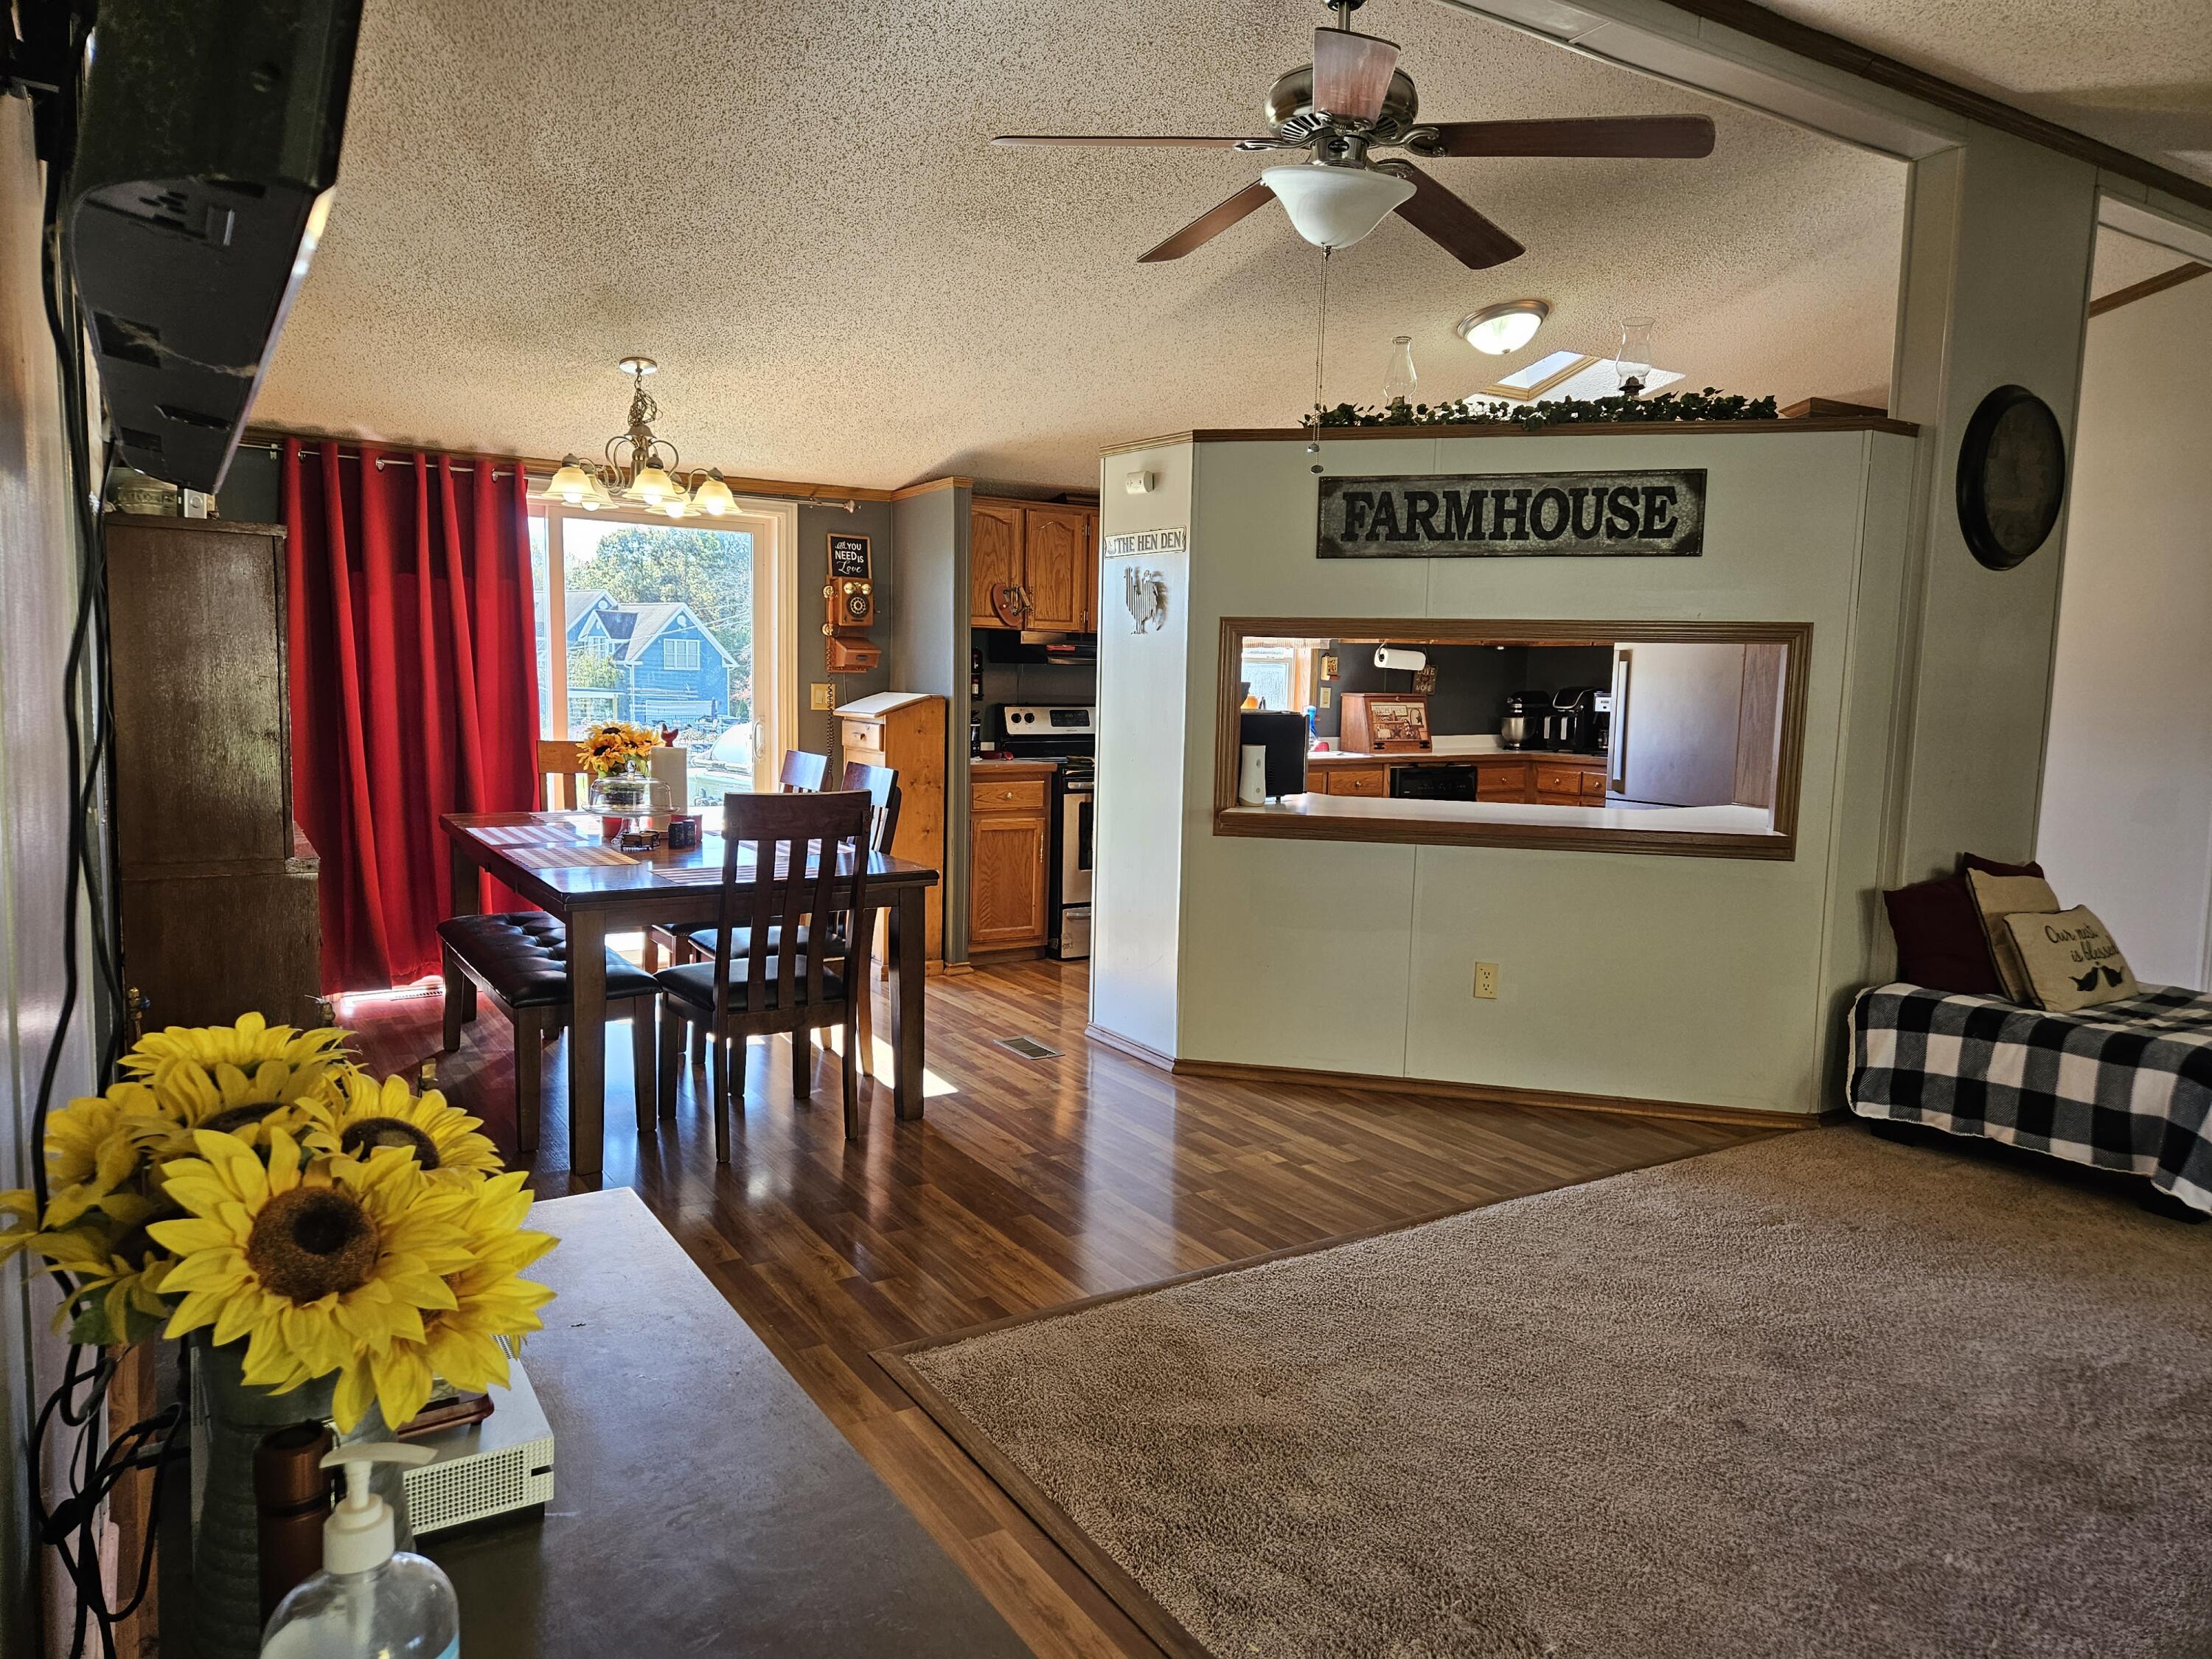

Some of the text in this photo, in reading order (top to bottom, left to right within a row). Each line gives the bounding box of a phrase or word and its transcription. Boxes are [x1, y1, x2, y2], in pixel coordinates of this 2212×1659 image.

[1340, 486, 1678, 542] FARMHOUSE
[846, 543, 862, 551] YOU
[1116, 531, 1181, 554] THE HEN DEN
[835, 550, 864, 563] NEED IS
[836, 560, 863, 574] Love
[2045, 925, 2076, 943] Our
[2070, 950, 2084, 962] is
